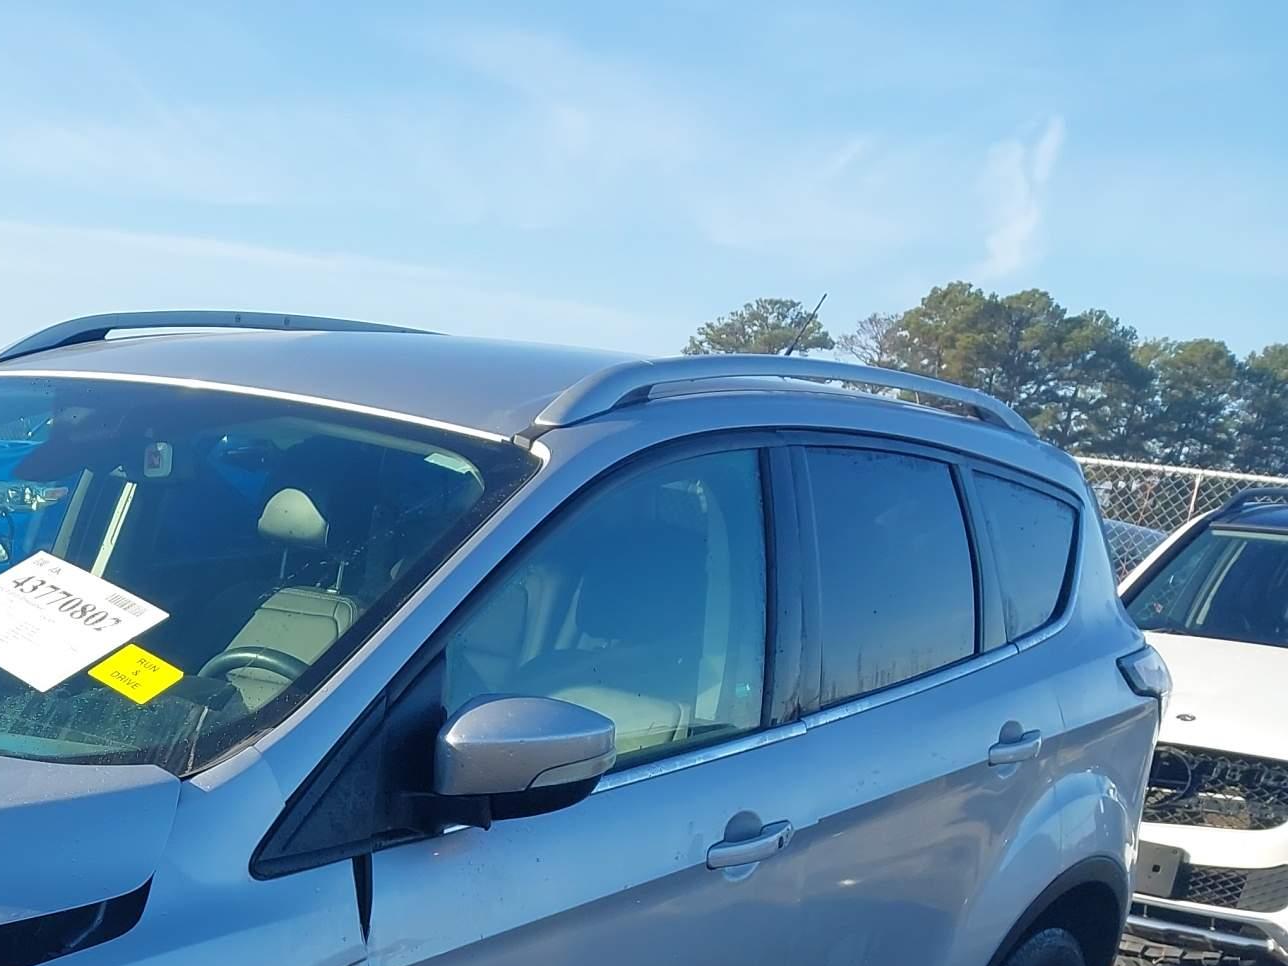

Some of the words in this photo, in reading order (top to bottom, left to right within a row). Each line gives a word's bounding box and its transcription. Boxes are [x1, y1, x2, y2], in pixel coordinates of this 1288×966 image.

[12, 575, 122, 631] 43770802
[136, 658, 160, 673] RUN
[110, 670, 142, 690] DRIVE
